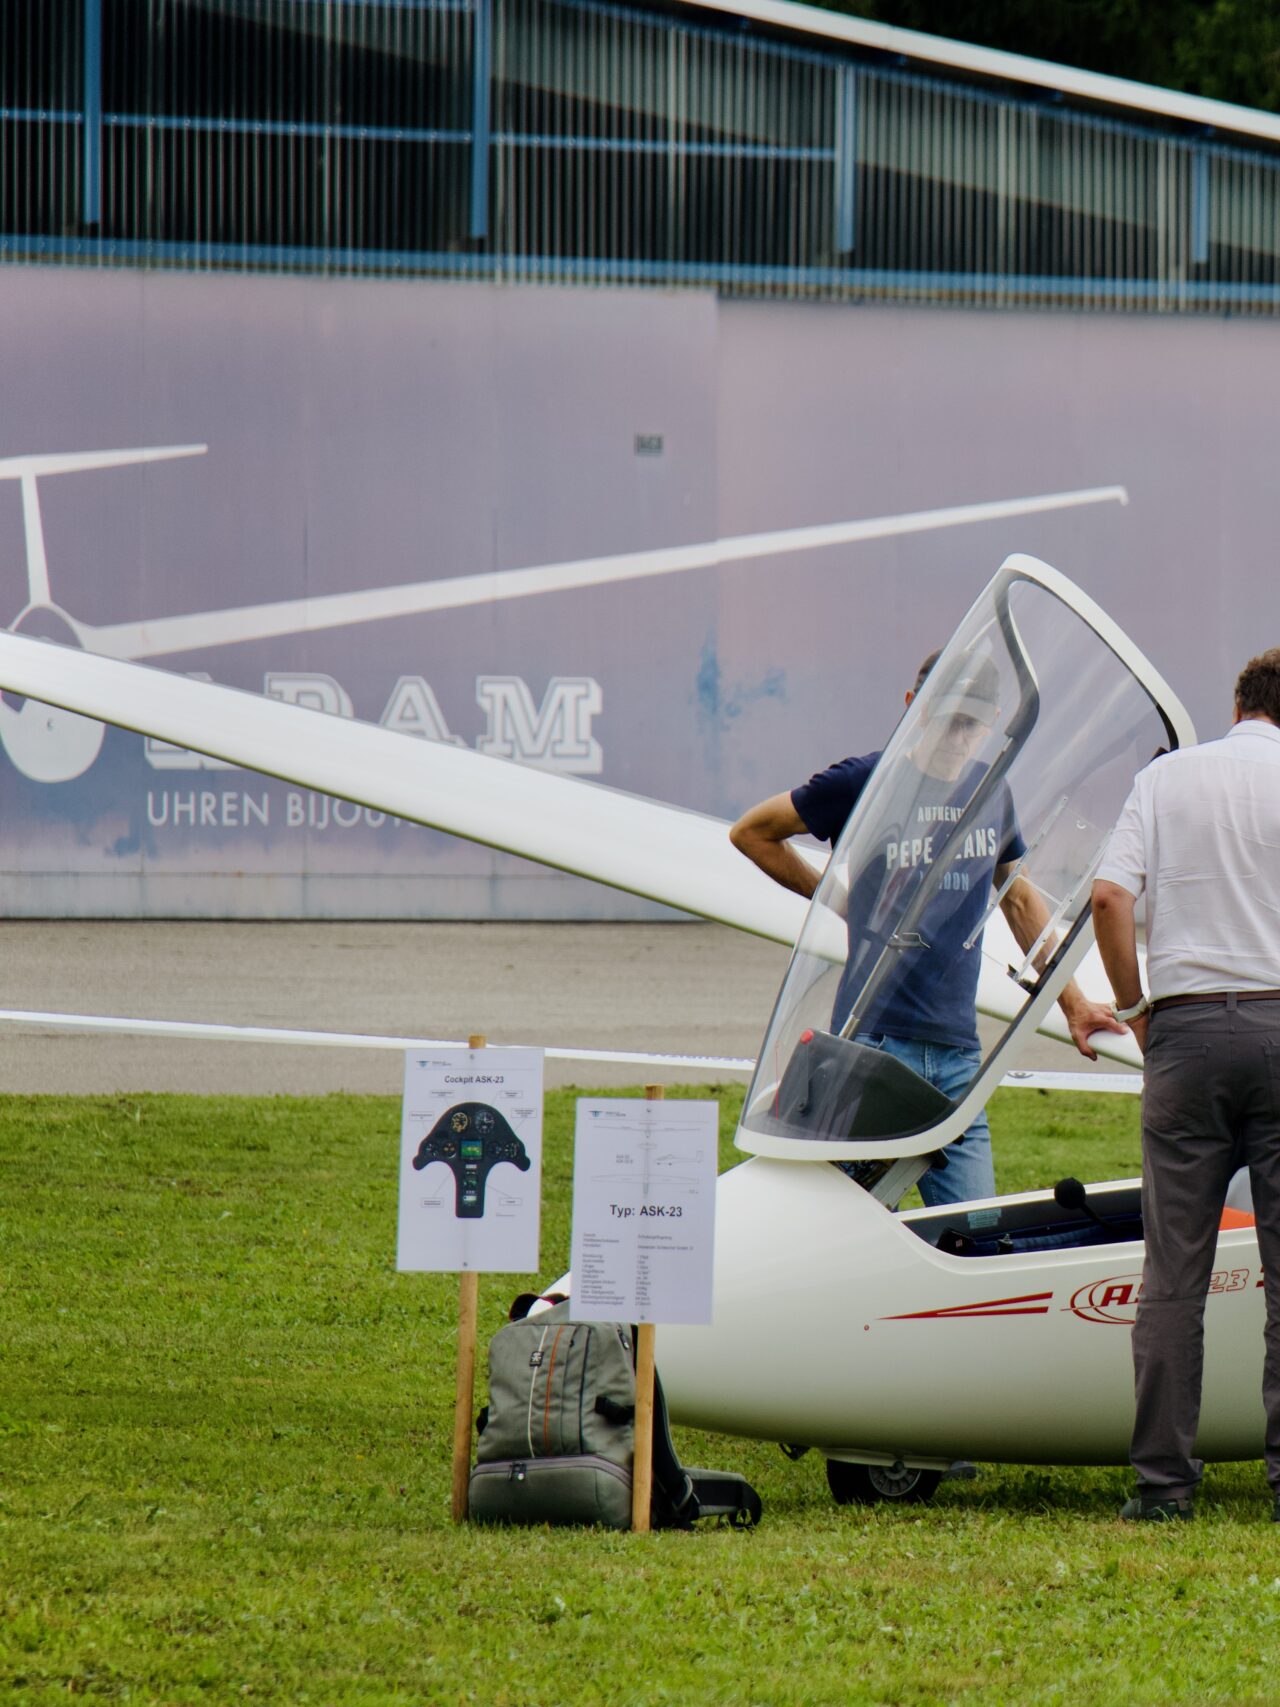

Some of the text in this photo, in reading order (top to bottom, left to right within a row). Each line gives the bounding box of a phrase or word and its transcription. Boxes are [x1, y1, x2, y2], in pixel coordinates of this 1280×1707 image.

[147, 792, 418, 829] UHREN BIJOU
[886, 828, 996, 870] PEPE ANS
[444, 1075, 504, 1084] Cockpit ASK-23
[610, 1204, 682, 1218] Typ: ASK-23
